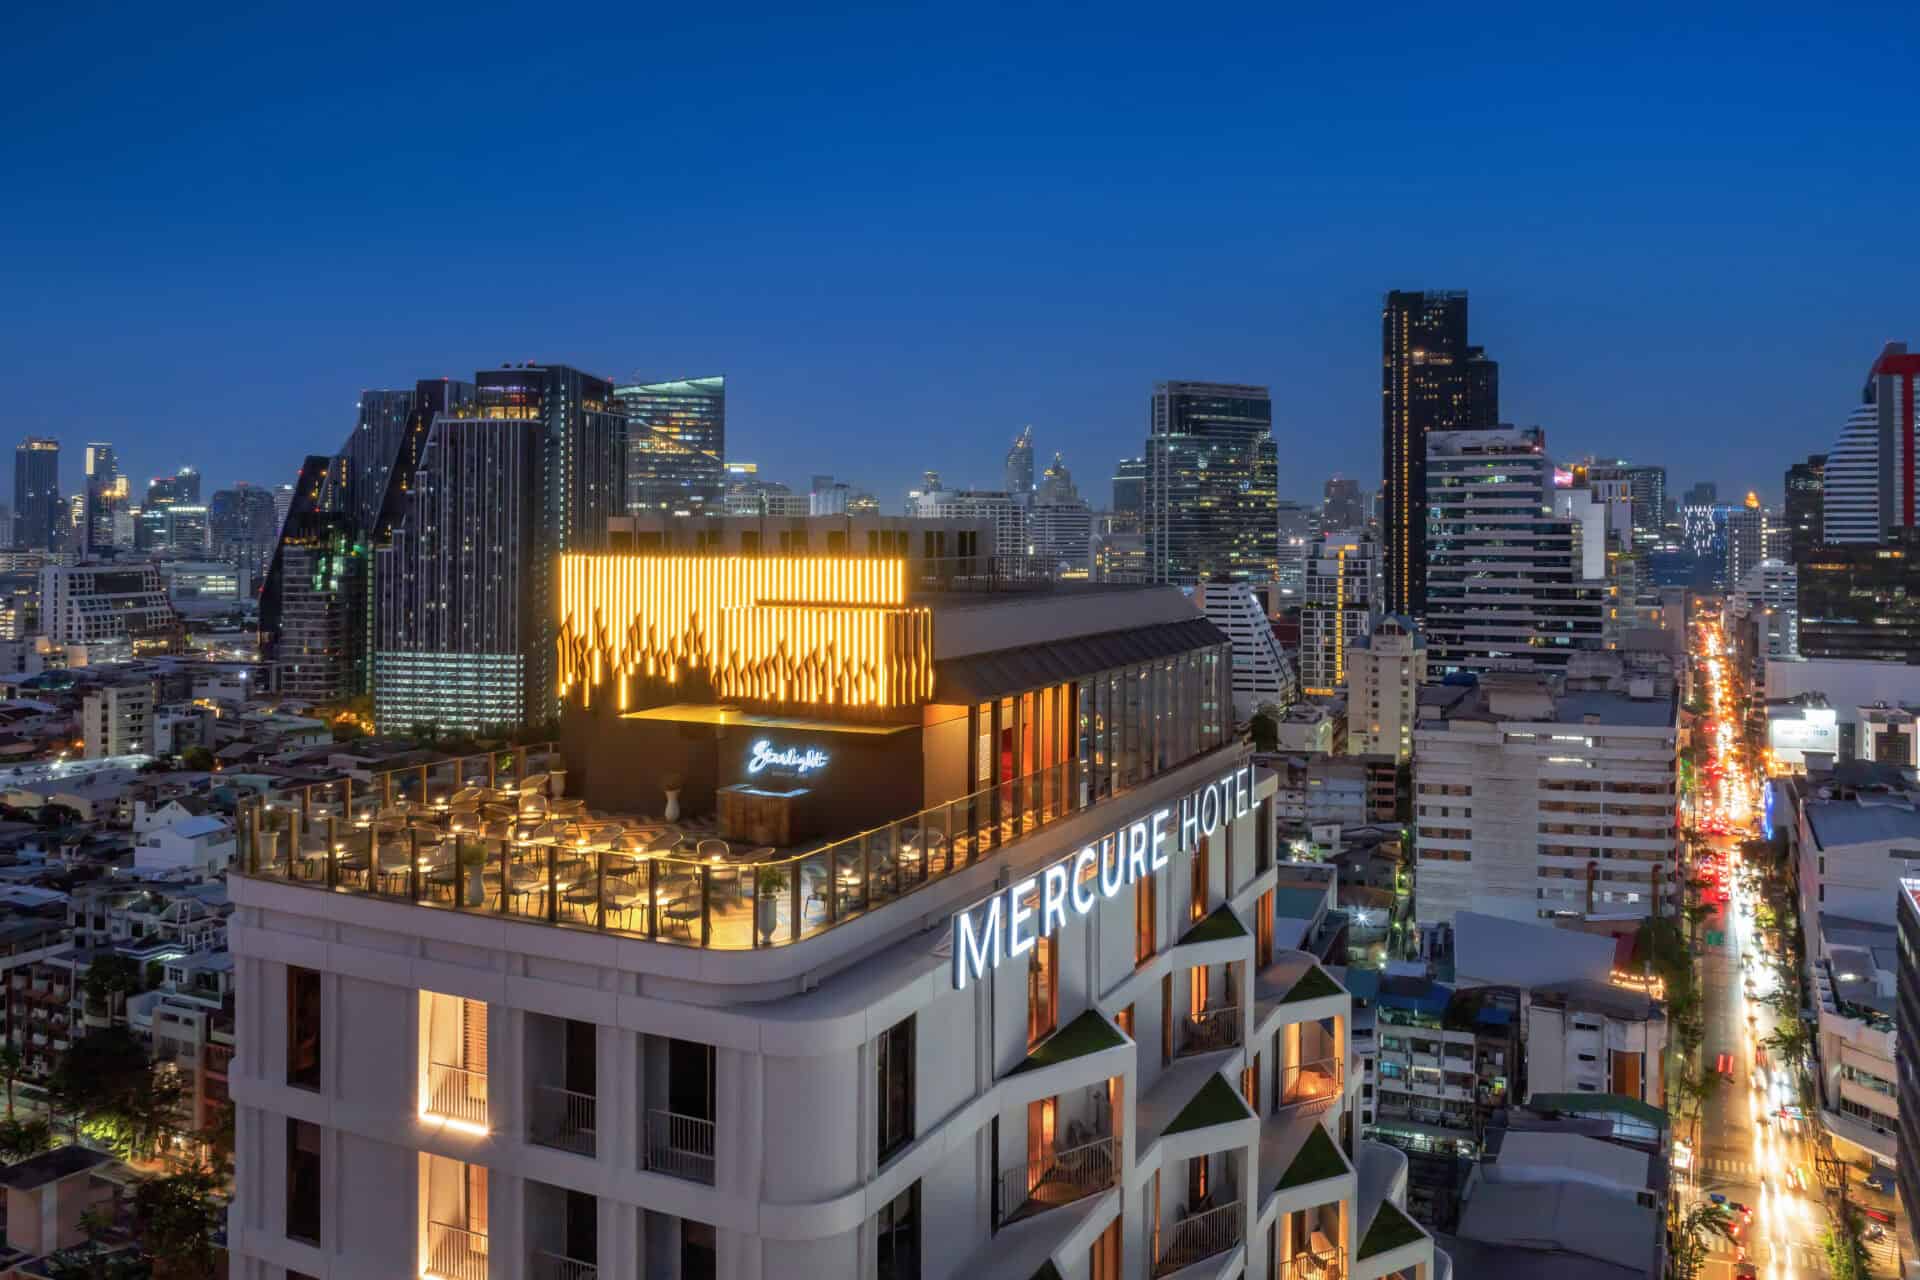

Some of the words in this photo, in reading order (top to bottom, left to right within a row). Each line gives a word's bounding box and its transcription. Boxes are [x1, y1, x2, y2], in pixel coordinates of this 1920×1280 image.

[748, 740, 829, 773] Starlight
[953, 809, 1169, 991] MERCURE
[1178, 763, 1261, 852] HOTEL
